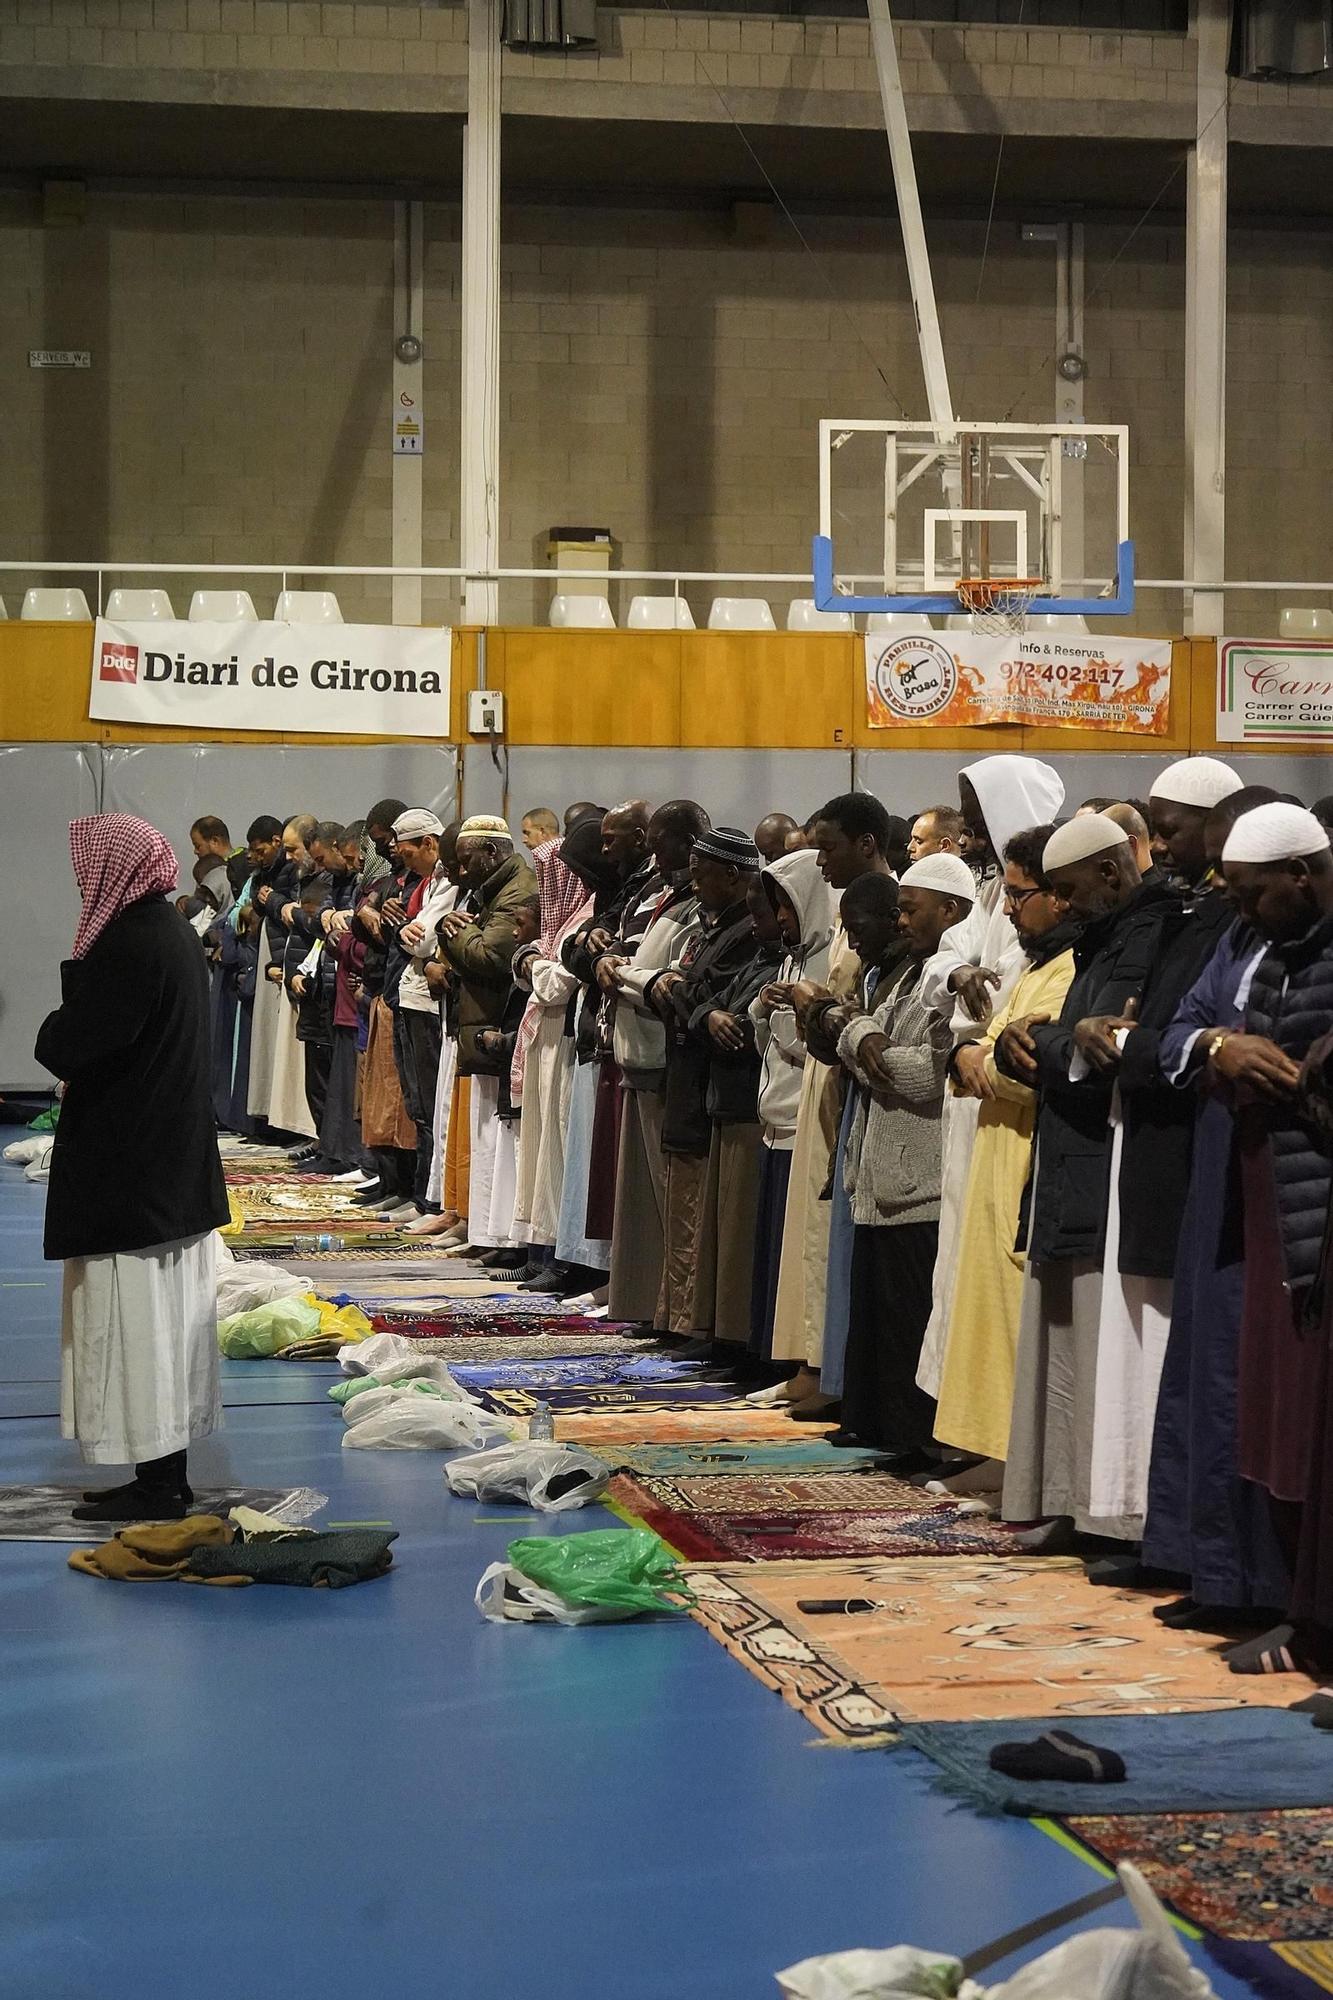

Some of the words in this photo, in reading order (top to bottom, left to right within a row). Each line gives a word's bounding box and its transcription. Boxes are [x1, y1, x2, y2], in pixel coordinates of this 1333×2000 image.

[883, 641, 935, 668] PARRILLA
[1020, 642, 1041, 654] Info
[1043, 644, 1051, 655] &
[1054, 645, 1105, 659] Reservas
[103, 655, 136, 671] DdG
[143, 652, 239, 685] Diari
[251, 657, 299, 688] de
[310, 660, 442, 693] Girona
[1000, 660, 1035, 680] 972
[1041, 664, 1082, 682] 402
[1088, 667, 1125, 688] 117
[884, 667, 951, 714] RESTAURANT
[903, 678, 939, 700] Brasa
[1127, 705, 1155, 713] GIRONA
[1245, 702, 1294, 711] Carrer
[1245, 712, 1294, 721] Carrer
